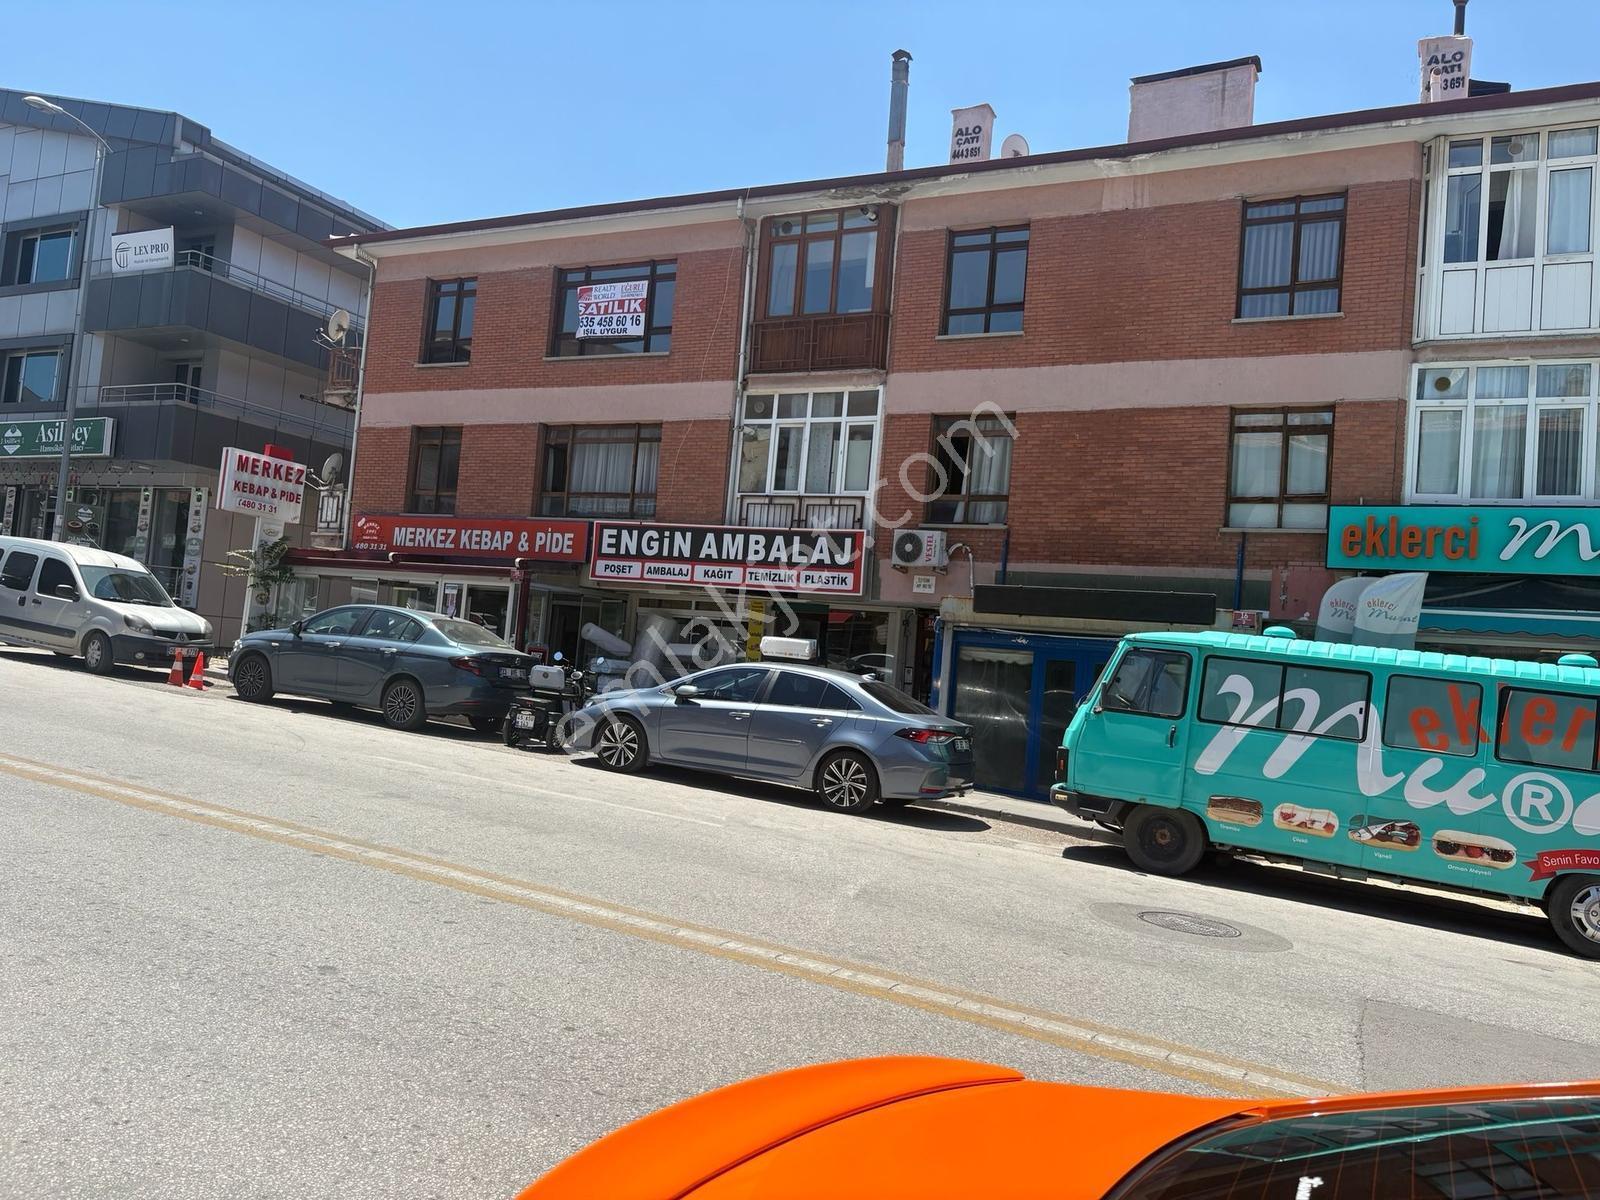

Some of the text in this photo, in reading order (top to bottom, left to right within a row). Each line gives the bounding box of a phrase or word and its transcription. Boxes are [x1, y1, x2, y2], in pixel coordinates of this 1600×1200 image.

[1427, 51, 1464, 66] ALO
[955, 125, 982, 137] ALO
[956, 135, 979, 147] ÇATI
[134, 242, 169, 256] LEX PRIO
[593, 284, 616, 293] REALTY
[578, 299, 643, 316] SATILIK
[596, 316, 613, 328] 458
[615, 315, 627, 327] 60
[630, 314, 641, 326] 16
[600, 327, 628, 335] UYGUR
[35, 421, 92, 446] Asiley
[236, 454, 305, 486] MERKEZ
[233, 480, 269, 497] KEBAP
[270, 488, 278, 499] &
[257, 503, 266, 511] 31
[268, 505, 277, 514] 31
[393, 526, 574, 554] MERKEZ KEBAP & PİDE
[1341, 514, 1480, 560] eklerci
[379, 543, 387, 551] 31
[698, 532, 852, 566] AMBALAJ
[925, 534, 934, 562] VESTEL
[604, 564, 633, 575] POŞET
[646, 566, 690, 578] AMBALAJ
[703, 566, 733, 580] KAĞIT
[748, 569, 795, 584] TEMİZLİK
[804, 571, 848, 586] PLASTİK
[1366, 598, 1399, 612] eklerci
[1543, 853, 1600, 867] Senin Favo
